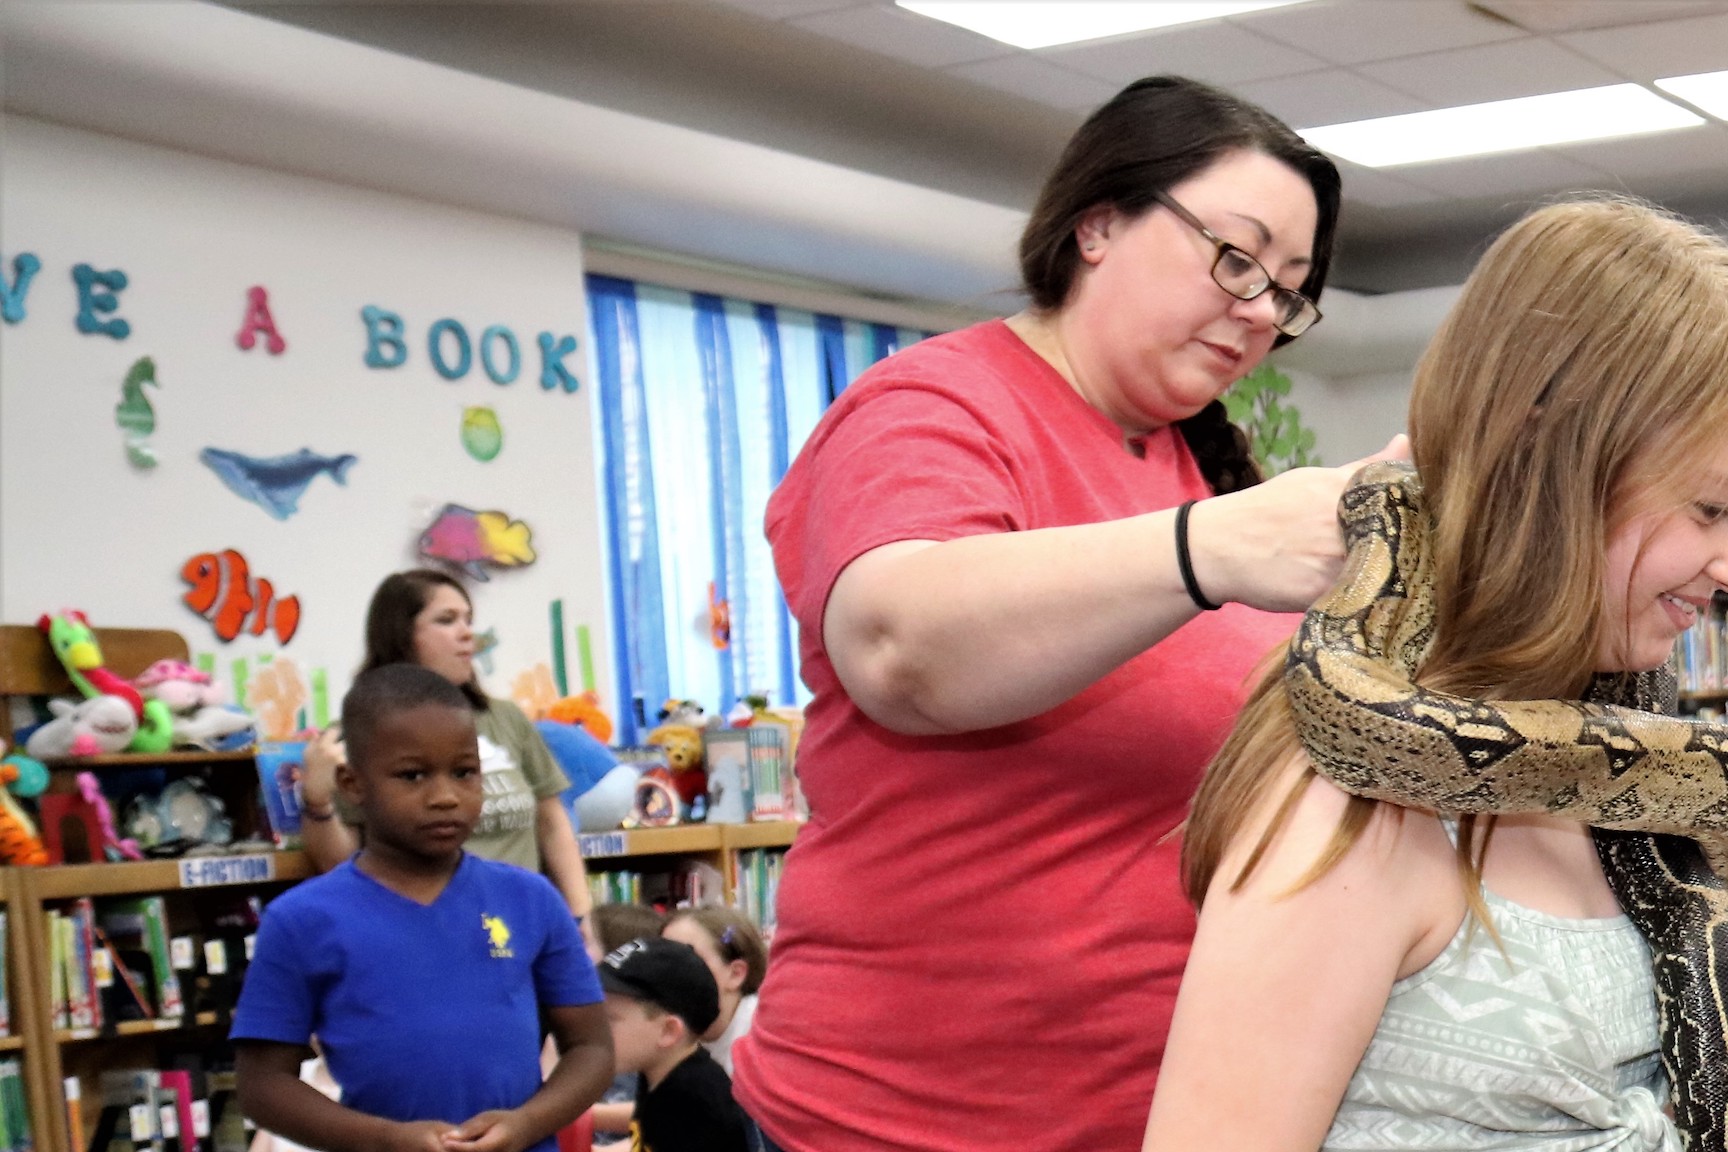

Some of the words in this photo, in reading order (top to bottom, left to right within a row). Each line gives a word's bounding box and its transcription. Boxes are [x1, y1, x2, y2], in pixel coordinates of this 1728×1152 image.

[236, 286, 286, 355] A
[360, 304, 580, 394] BOOK
[579, 834, 624, 857] ICTION
[184, 858, 269, 885] E-FICTION
